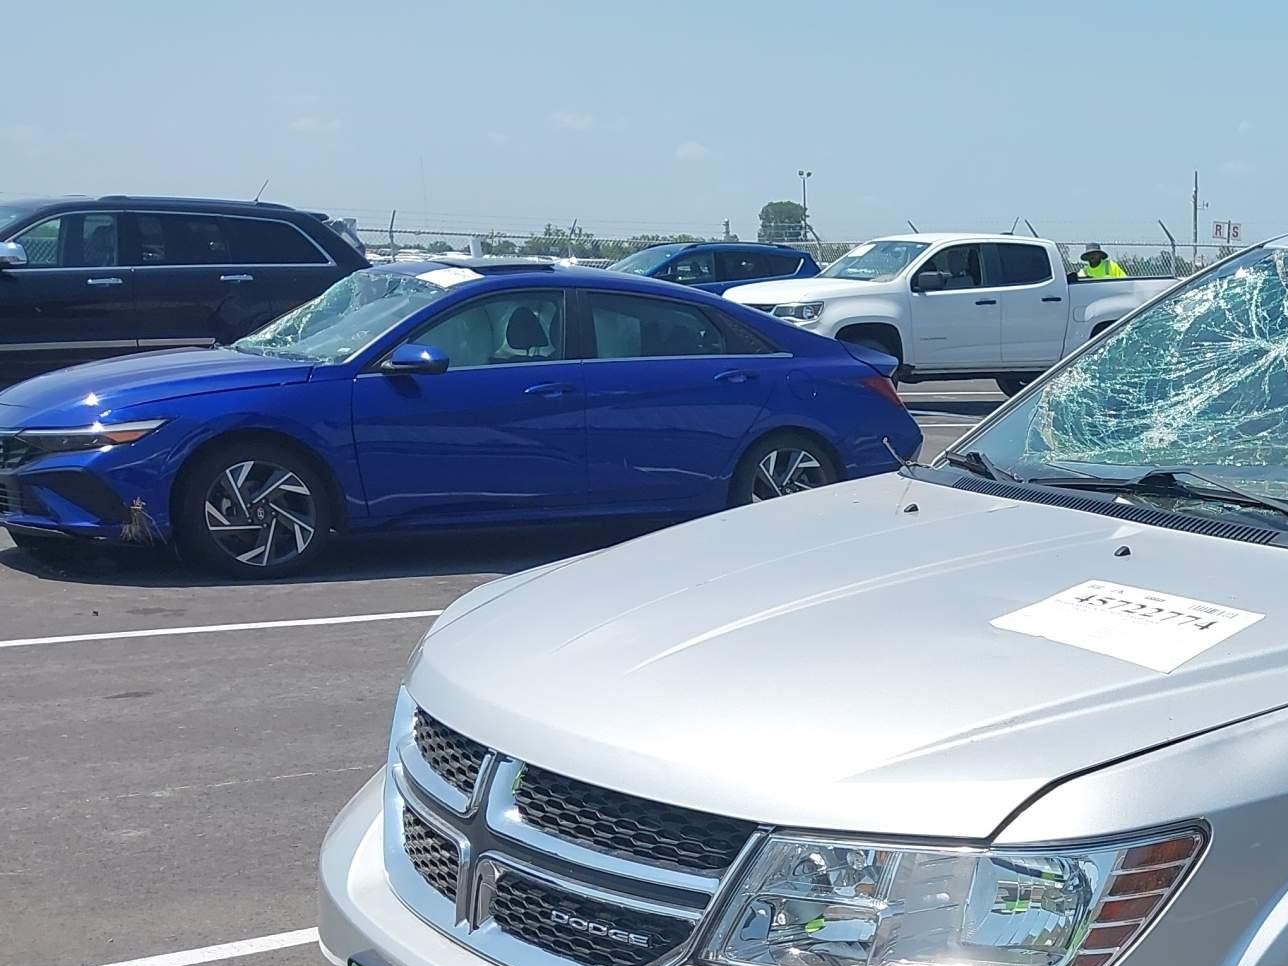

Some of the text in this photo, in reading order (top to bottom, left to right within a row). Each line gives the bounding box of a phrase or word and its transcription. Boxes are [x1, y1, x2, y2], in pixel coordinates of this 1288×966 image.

[1215, 224, 1239, 238] R S
[1074, 594, 1218, 630] 45722774
[551, 910, 649, 948] DODGE
